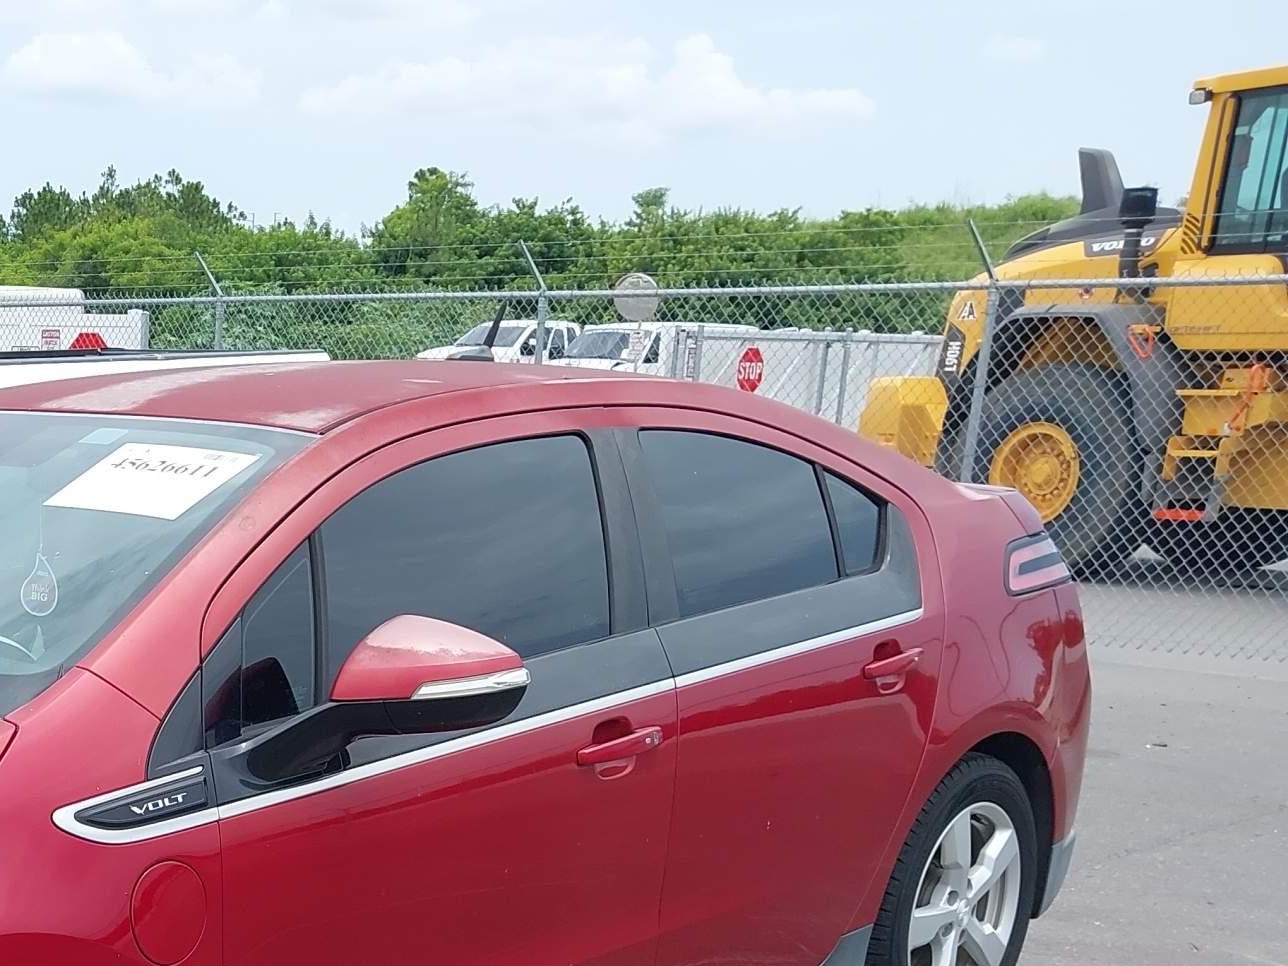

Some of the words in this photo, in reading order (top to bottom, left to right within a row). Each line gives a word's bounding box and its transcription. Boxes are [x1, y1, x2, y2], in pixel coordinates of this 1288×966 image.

[1092, 237, 1155, 251] VOLO
[738, 361, 764, 380] STOP
[112, 457, 219, 478] 45626611
[130, 793, 186, 815] VOLT
